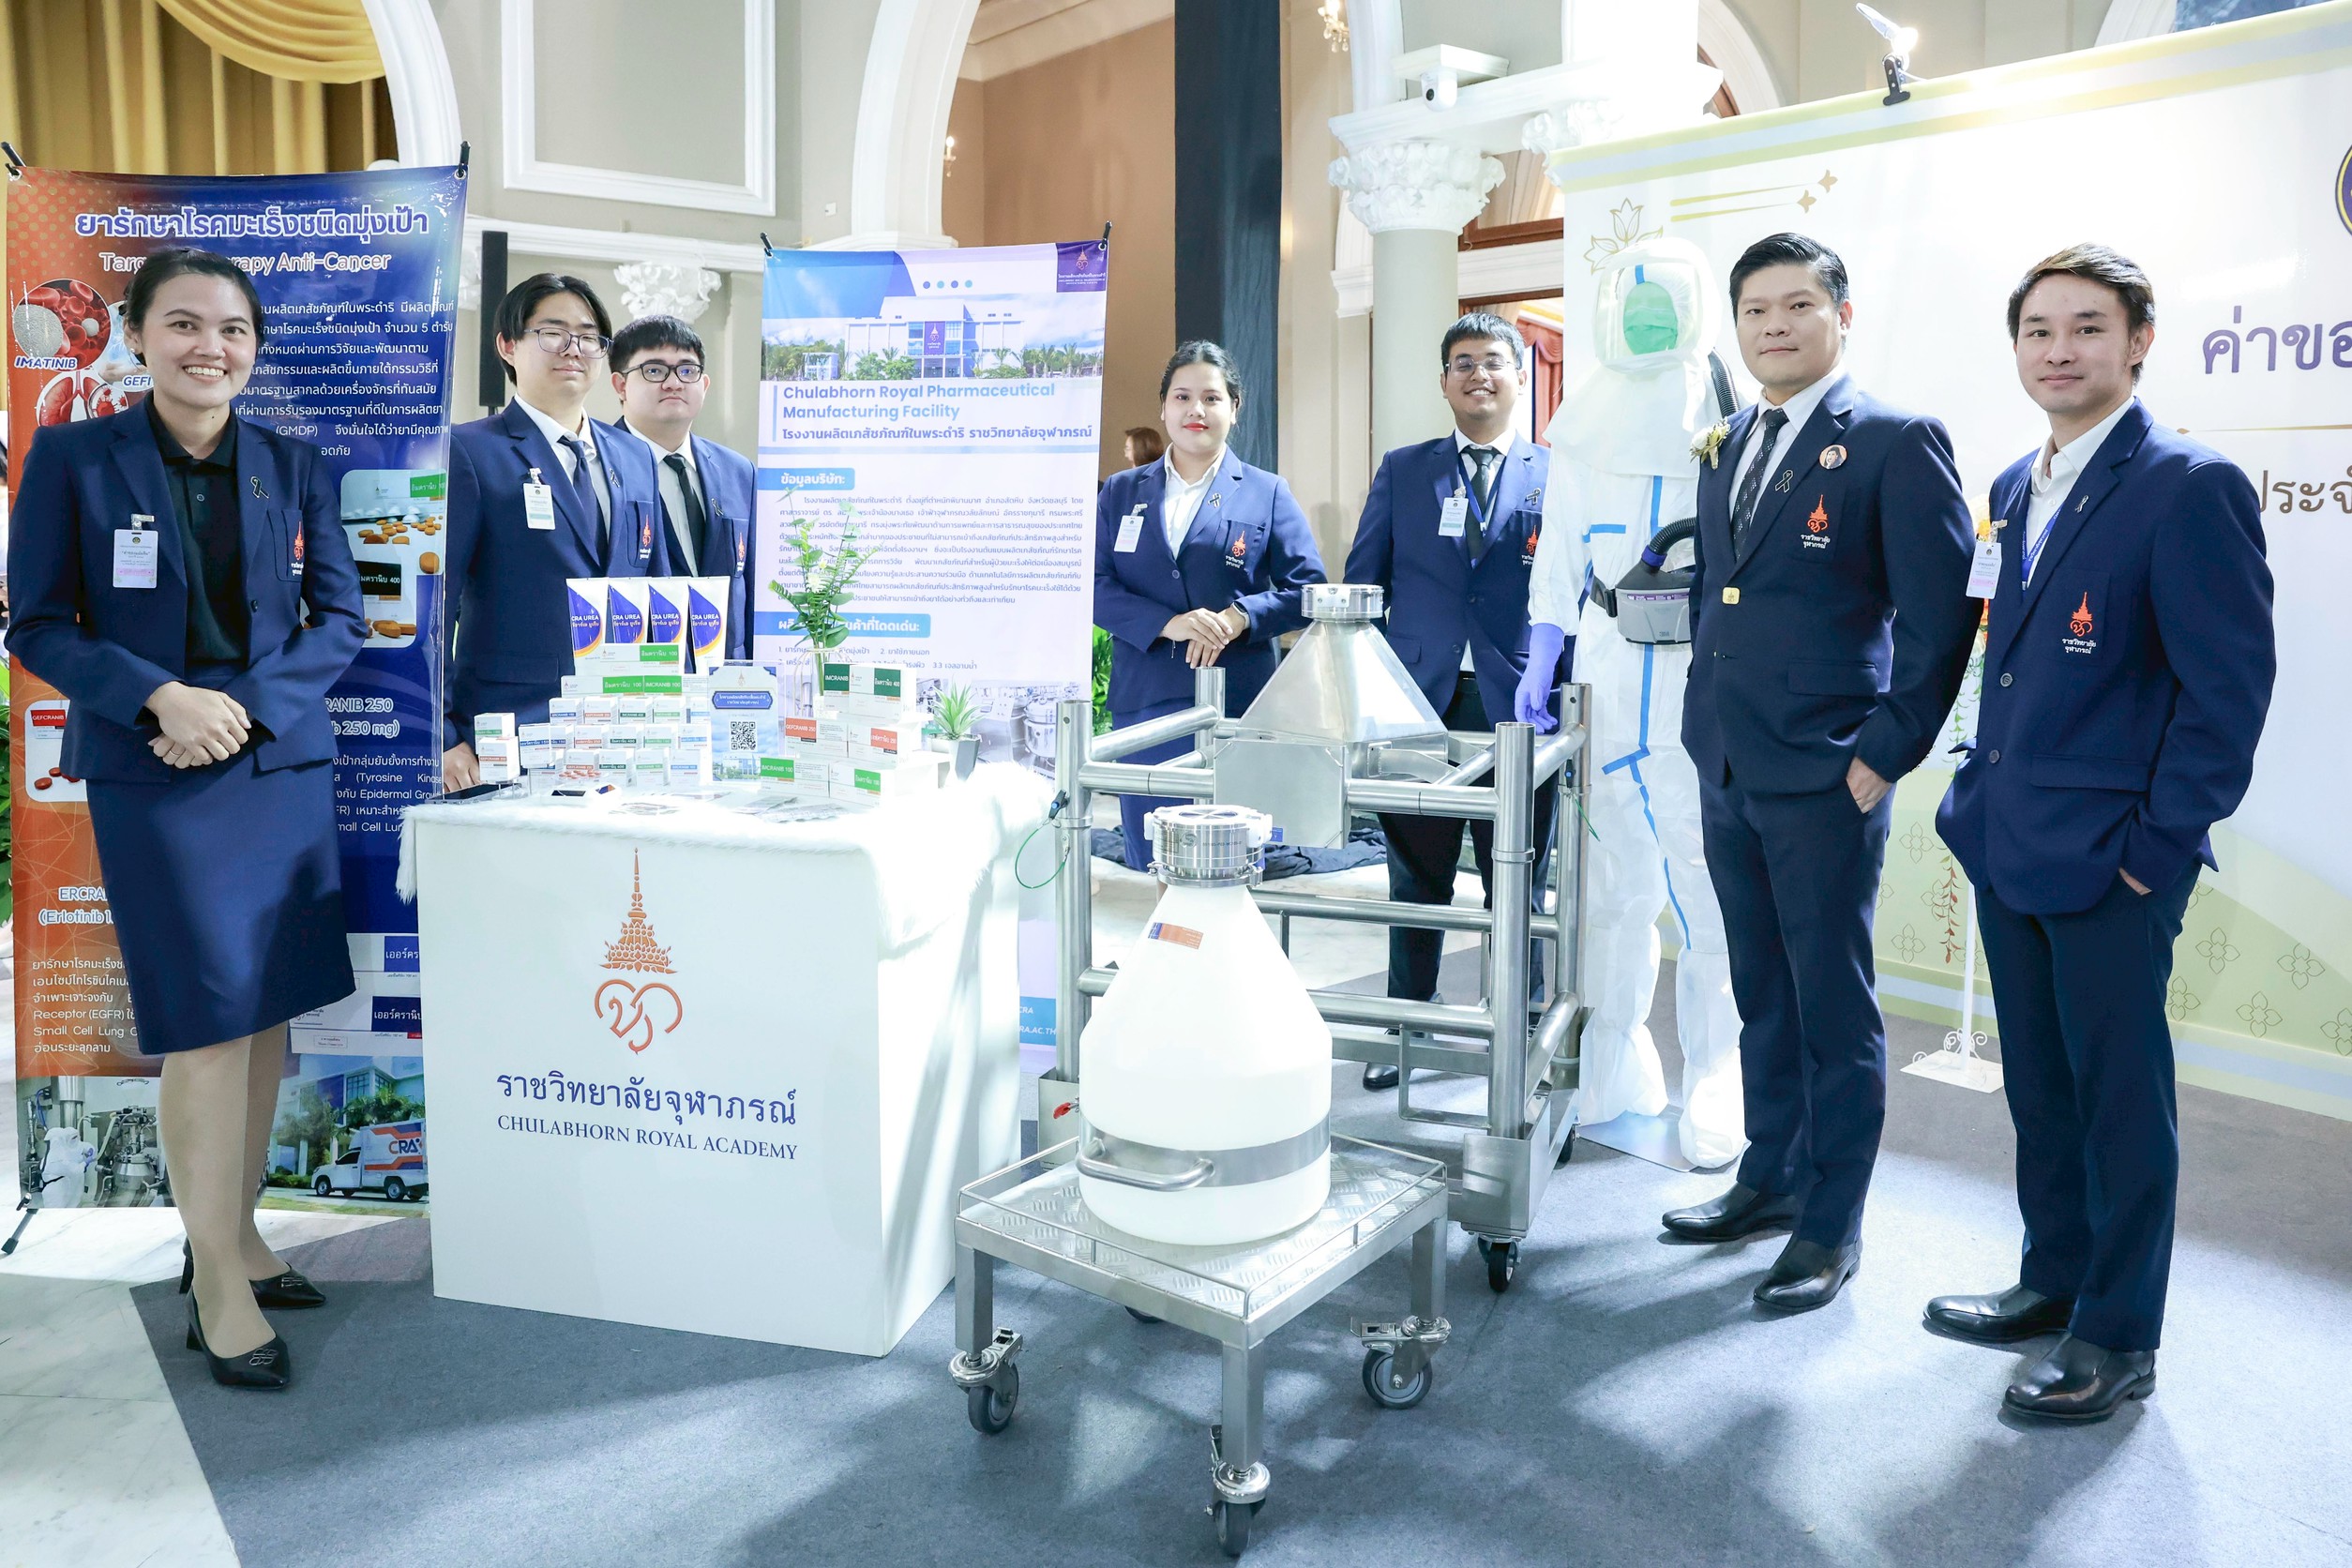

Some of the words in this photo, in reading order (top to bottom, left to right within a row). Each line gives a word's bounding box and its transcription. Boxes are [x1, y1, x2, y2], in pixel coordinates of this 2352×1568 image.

[75, 205, 430, 245] ยารักษาโรคมะเร็งชนิดมุ่งเป้า
[98, 251, 148, 275] Targ
[279, 251, 392, 274] Anti-Cancer
[263, 321, 381, 337] กษาโรคมะเร็งชนิดมุ่งเป้า
[384, 323, 418, 333] จำนวน
[421, 323, 429, 333] 5
[431, 322, 454, 333] ตำรับ
[257, 341, 430, 355] ทั้งหมดผ่านการวิจัยและพัฒนาตาม
[14, 356, 78, 369] IMATINIB
[783, 385, 876, 400] Chulabhorn
[879, 384, 924, 401] Royal
[927, 383, 1056, 398] Pharmaceutical
[782, 404, 898, 422] Manufacturing
[902, 404, 960, 420] Facility
[276, 425, 318, 437] (GMDP)
[782, 426, 965, 441] โรงงานผลิตเภสัชภัณฑ์ในพระดำริ
[969, 425, 1093, 442] ราชวิทยาลัยจุฬาภรณ์
[780, 473, 846, 487] ข้อมูลบริษัท:
[389, 575, 401, 583] 400
[365, 698, 394, 713] 250
[342, 721, 370, 735] 250
[371, 718, 400, 738] mg)
[355, 772, 403, 785] (Tyrosine
[360, 790, 413, 801] Epidermal
[361, 822, 381, 832] Cell
[38, 909, 104, 925] (Erlotinib
[33, 1009, 86, 1020] Receptor
[88, 1009, 125, 1020] (EGFR)
[34, 1025, 68, 1036] Small
[72, 1025, 93, 1036] Cell
[98, 1026, 125, 1038] Lung
[34, 1042, 111, 1056] อ่อนระยะลุกลาม
[497, 1070, 796, 1125] ราชวิทยาลัยจุฬาภรณ์
[498, 1115, 630, 1142] CHULABHORN
[636, 1129, 698, 1150] ROYAL
[703, 1137, 797, 1160] ACADEMY
